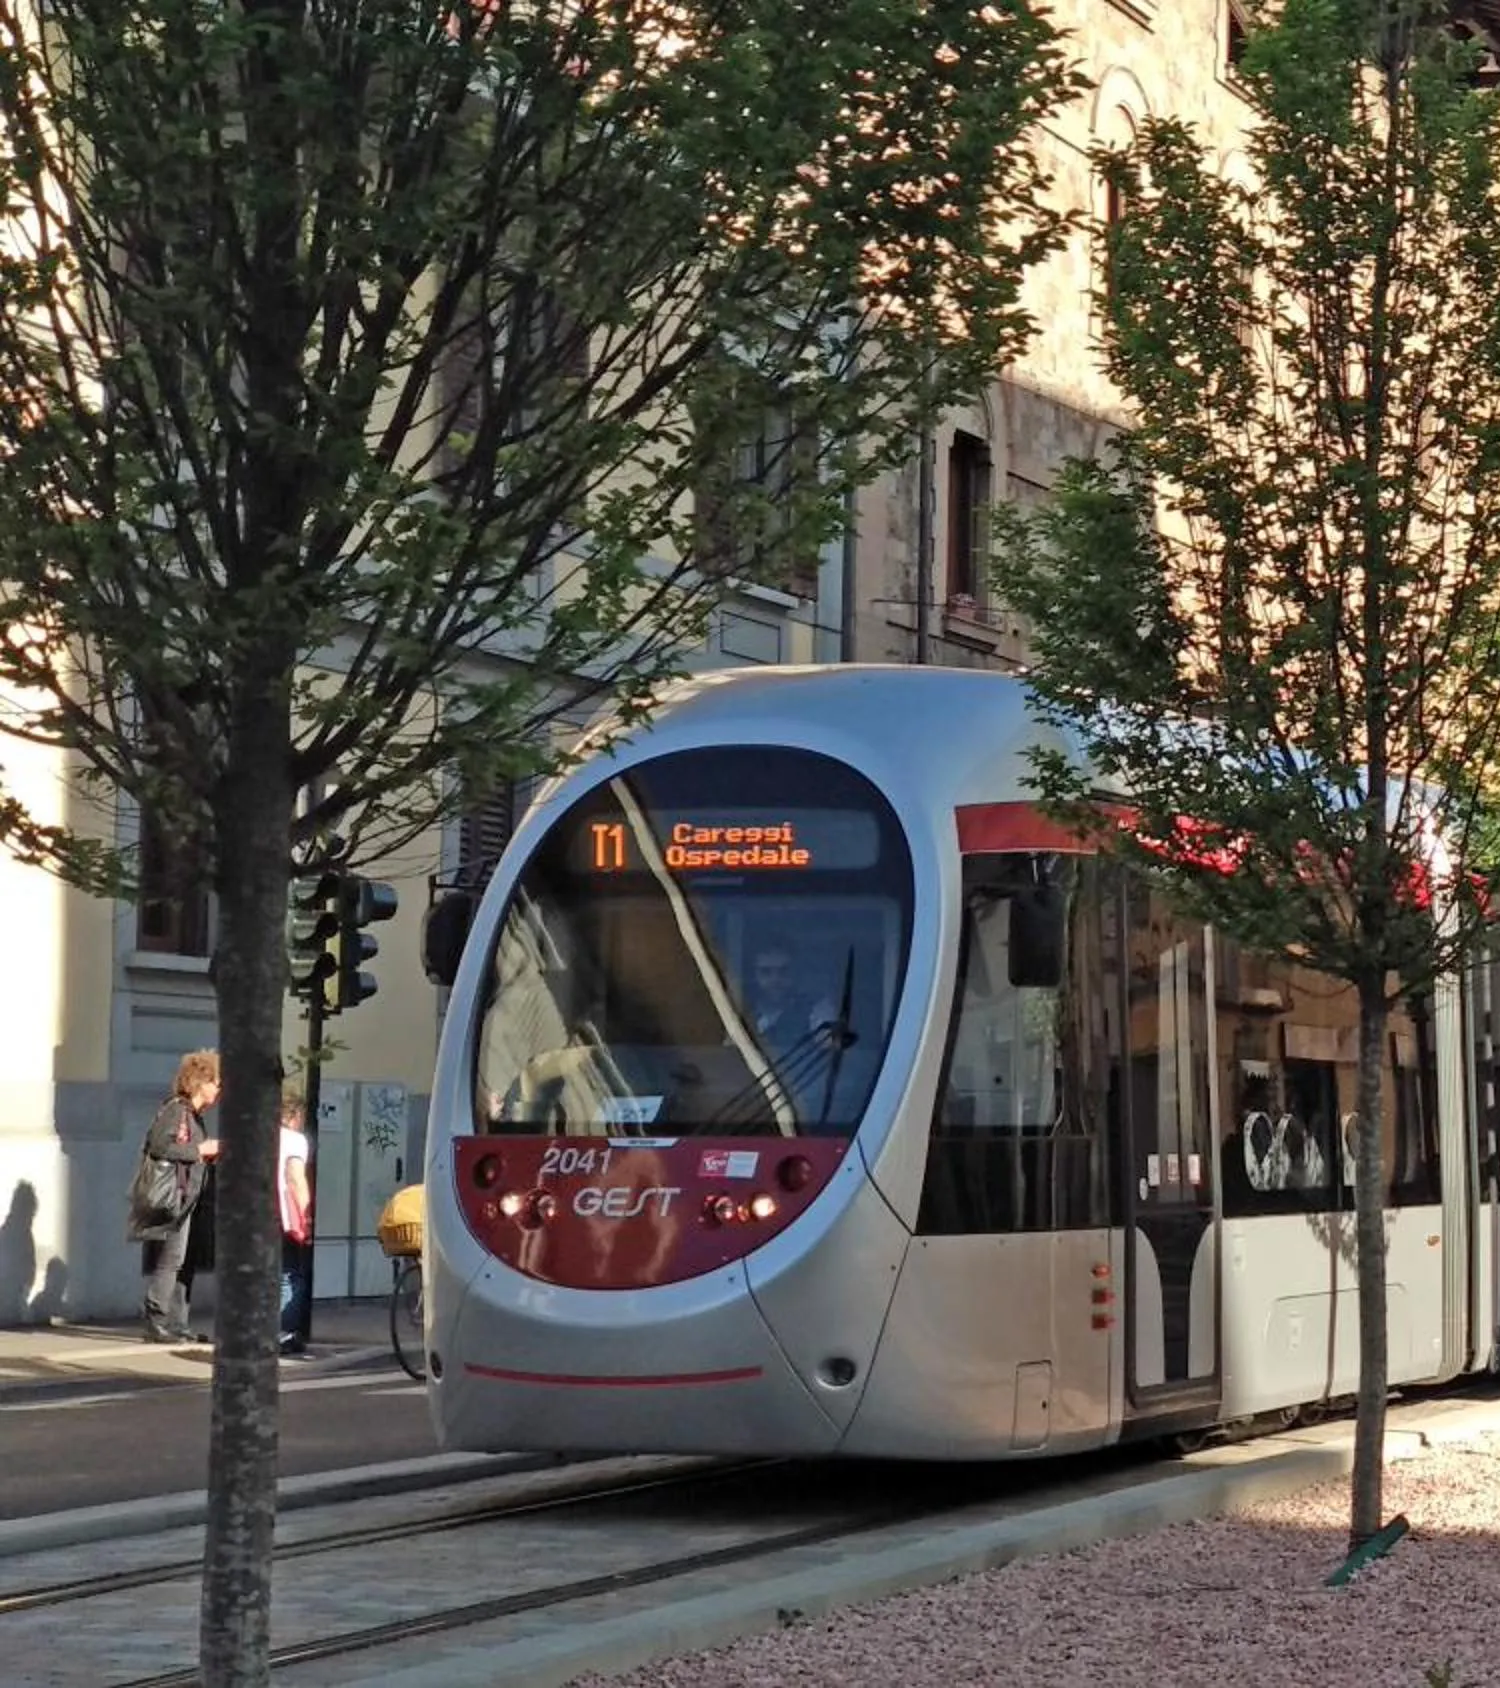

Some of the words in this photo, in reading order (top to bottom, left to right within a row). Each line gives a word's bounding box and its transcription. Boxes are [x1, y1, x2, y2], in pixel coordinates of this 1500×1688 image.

[592, 824, 624, 867] T1
[666, 845, 809, 866] Ospedale
[541, 1147, 612, 1175] 2041
[572, 1187, 681, 1217] GEST
